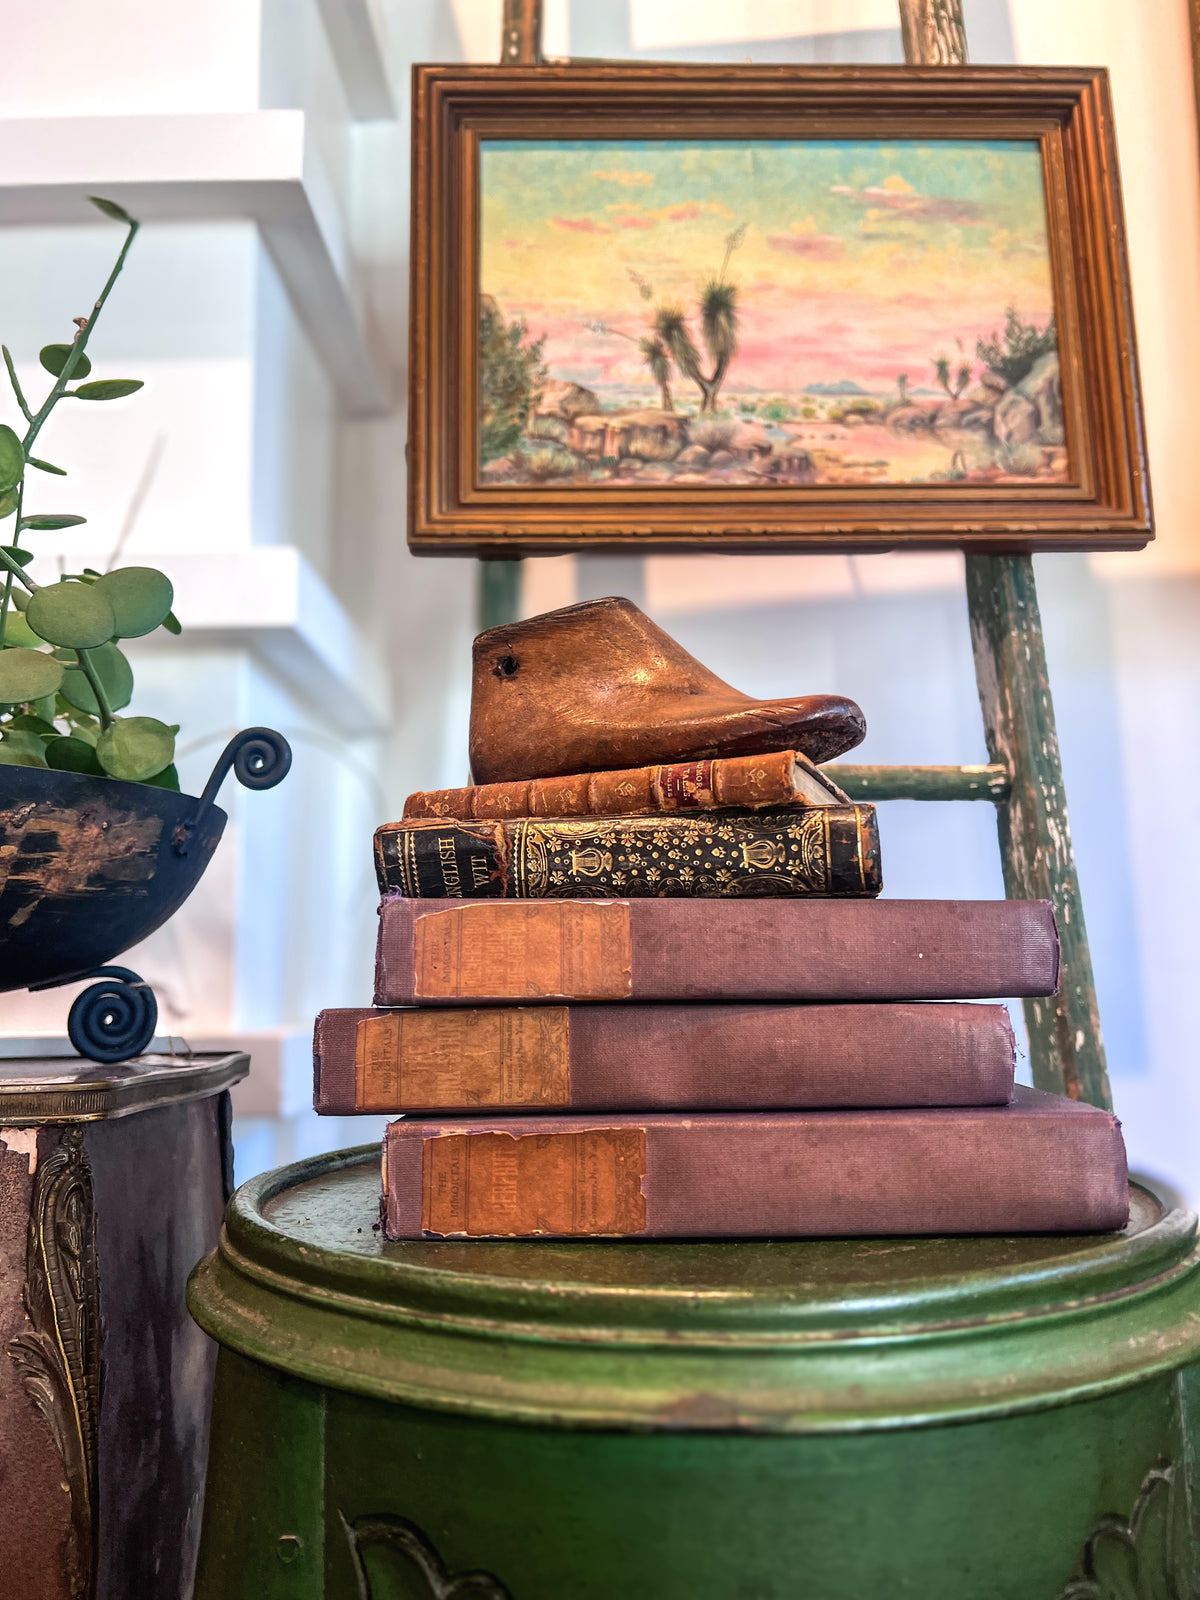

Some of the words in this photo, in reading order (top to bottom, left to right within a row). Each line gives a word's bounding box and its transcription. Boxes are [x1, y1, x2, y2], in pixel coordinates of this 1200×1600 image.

[470, 855, 491, 889] WIT
[371, 1051, 380, 1073] THE
[383, 1028, 393, 1094] IMMORTALS
[438, 1171, 447, 1197] THE
[450, 1147, 460, 1218] IMMORTALS
